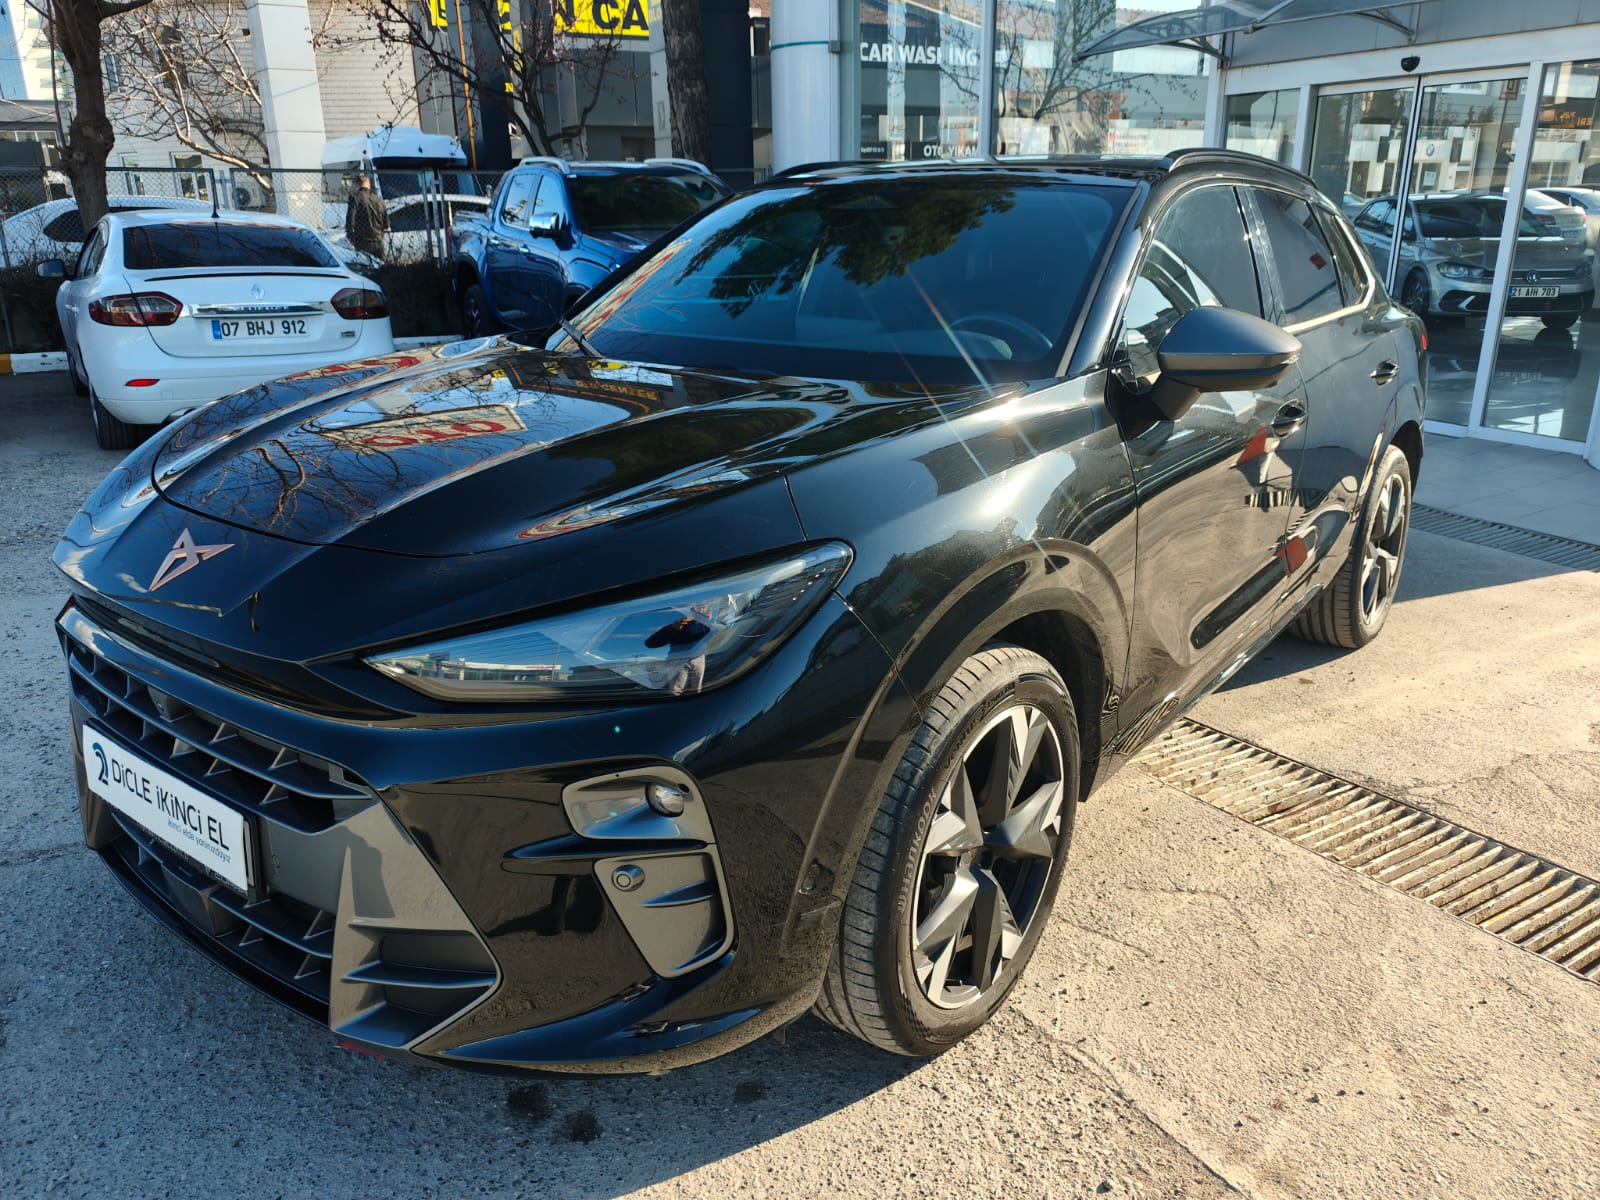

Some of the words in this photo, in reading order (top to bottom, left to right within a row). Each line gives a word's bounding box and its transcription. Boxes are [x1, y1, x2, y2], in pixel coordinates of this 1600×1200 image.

[1512, 287, 1521, 297] 21
[221, 321, 239, 337] 07
[247, 320, 275, 336] BHJ
[281, 319, 306, 335] 912
[207, 815, 230, 851] EL
